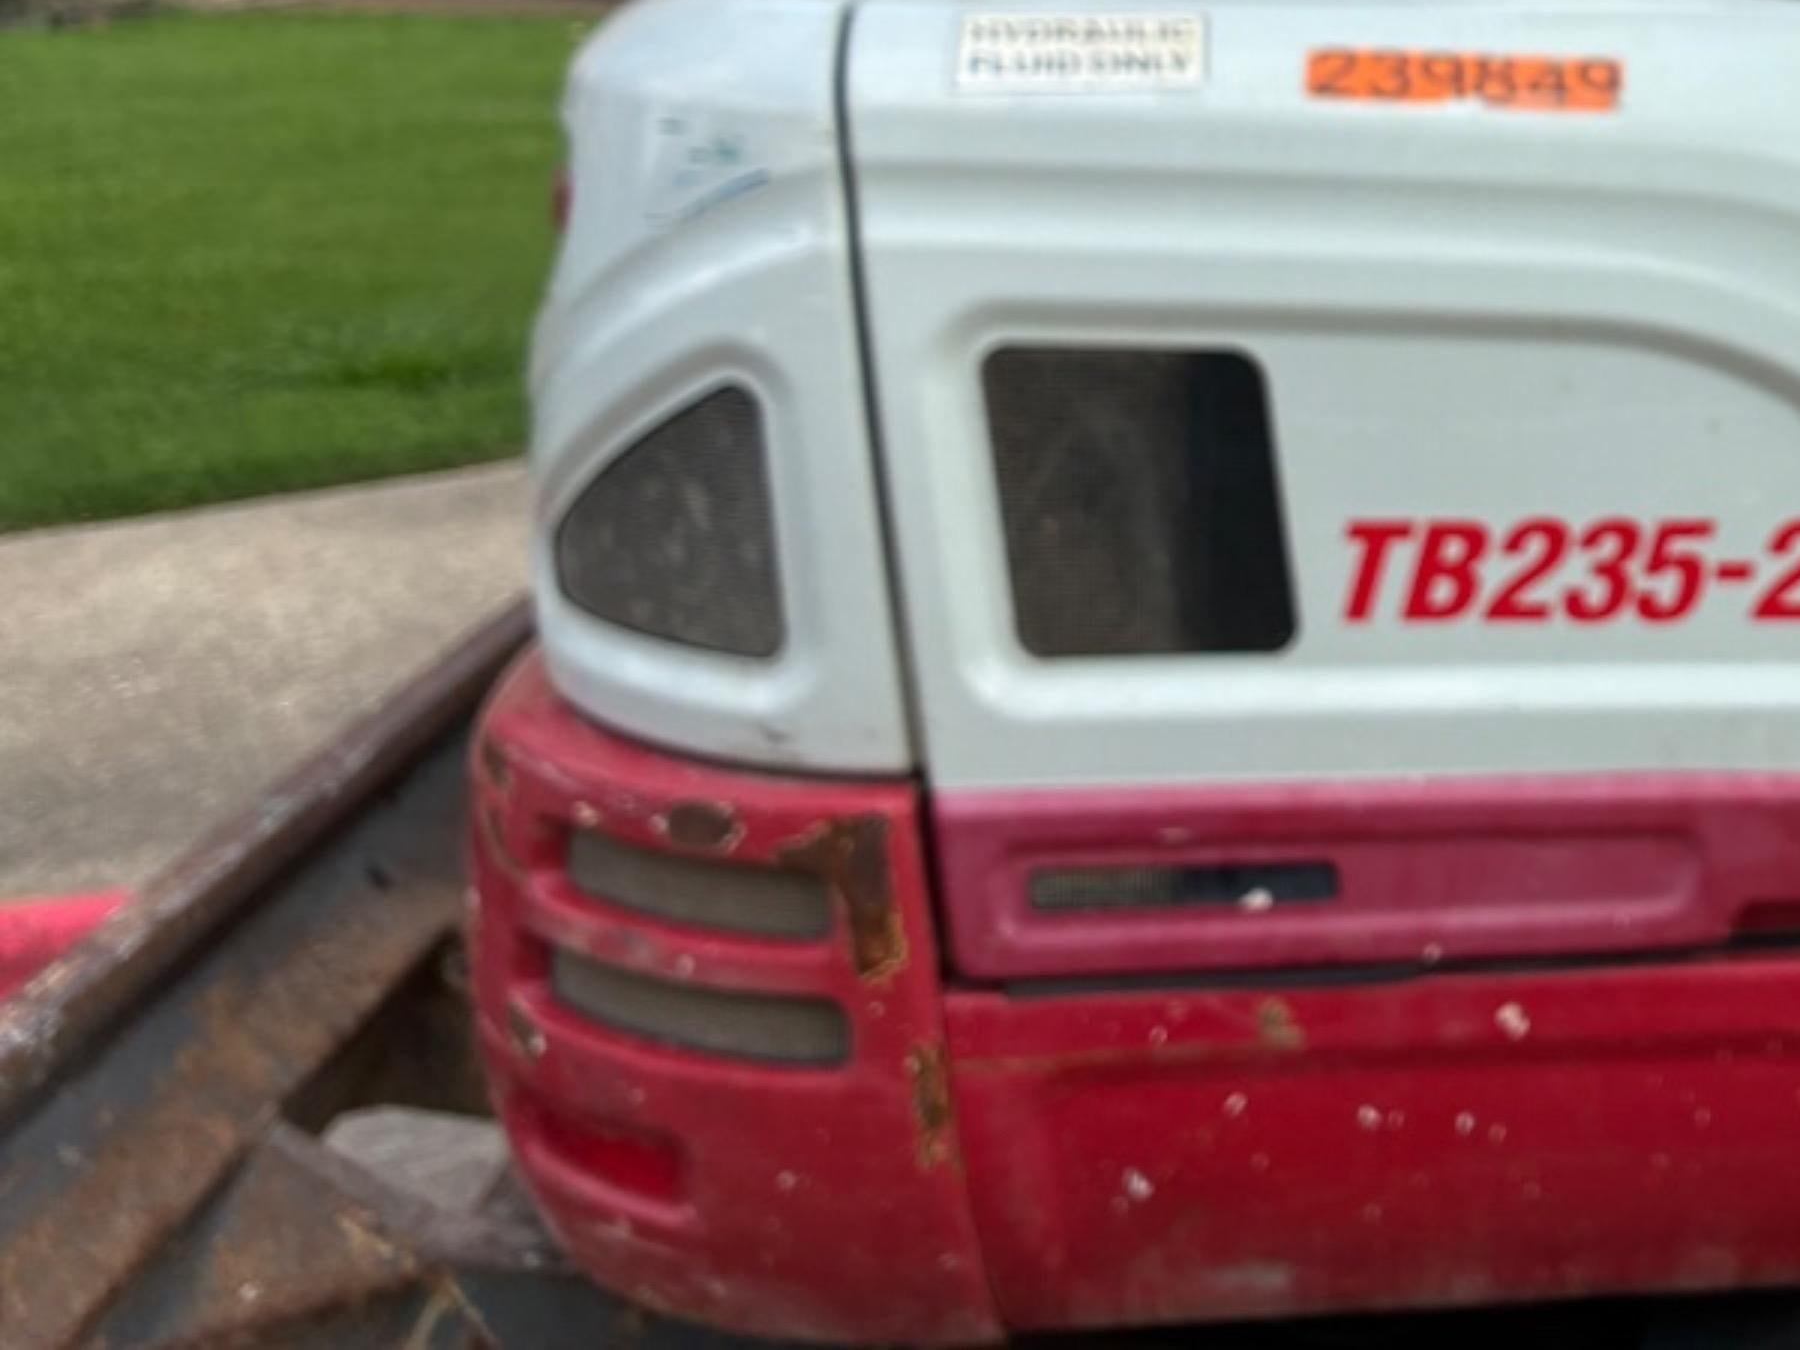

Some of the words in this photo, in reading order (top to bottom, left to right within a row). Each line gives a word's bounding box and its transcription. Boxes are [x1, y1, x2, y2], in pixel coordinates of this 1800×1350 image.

[968, 17, 1196, 45] HYDRAULIC
[967, 50, 1084, 77] FLUID
[1089, 51, 1194, 78] ONLY
[1305, 49, 1621, 108] 239849
